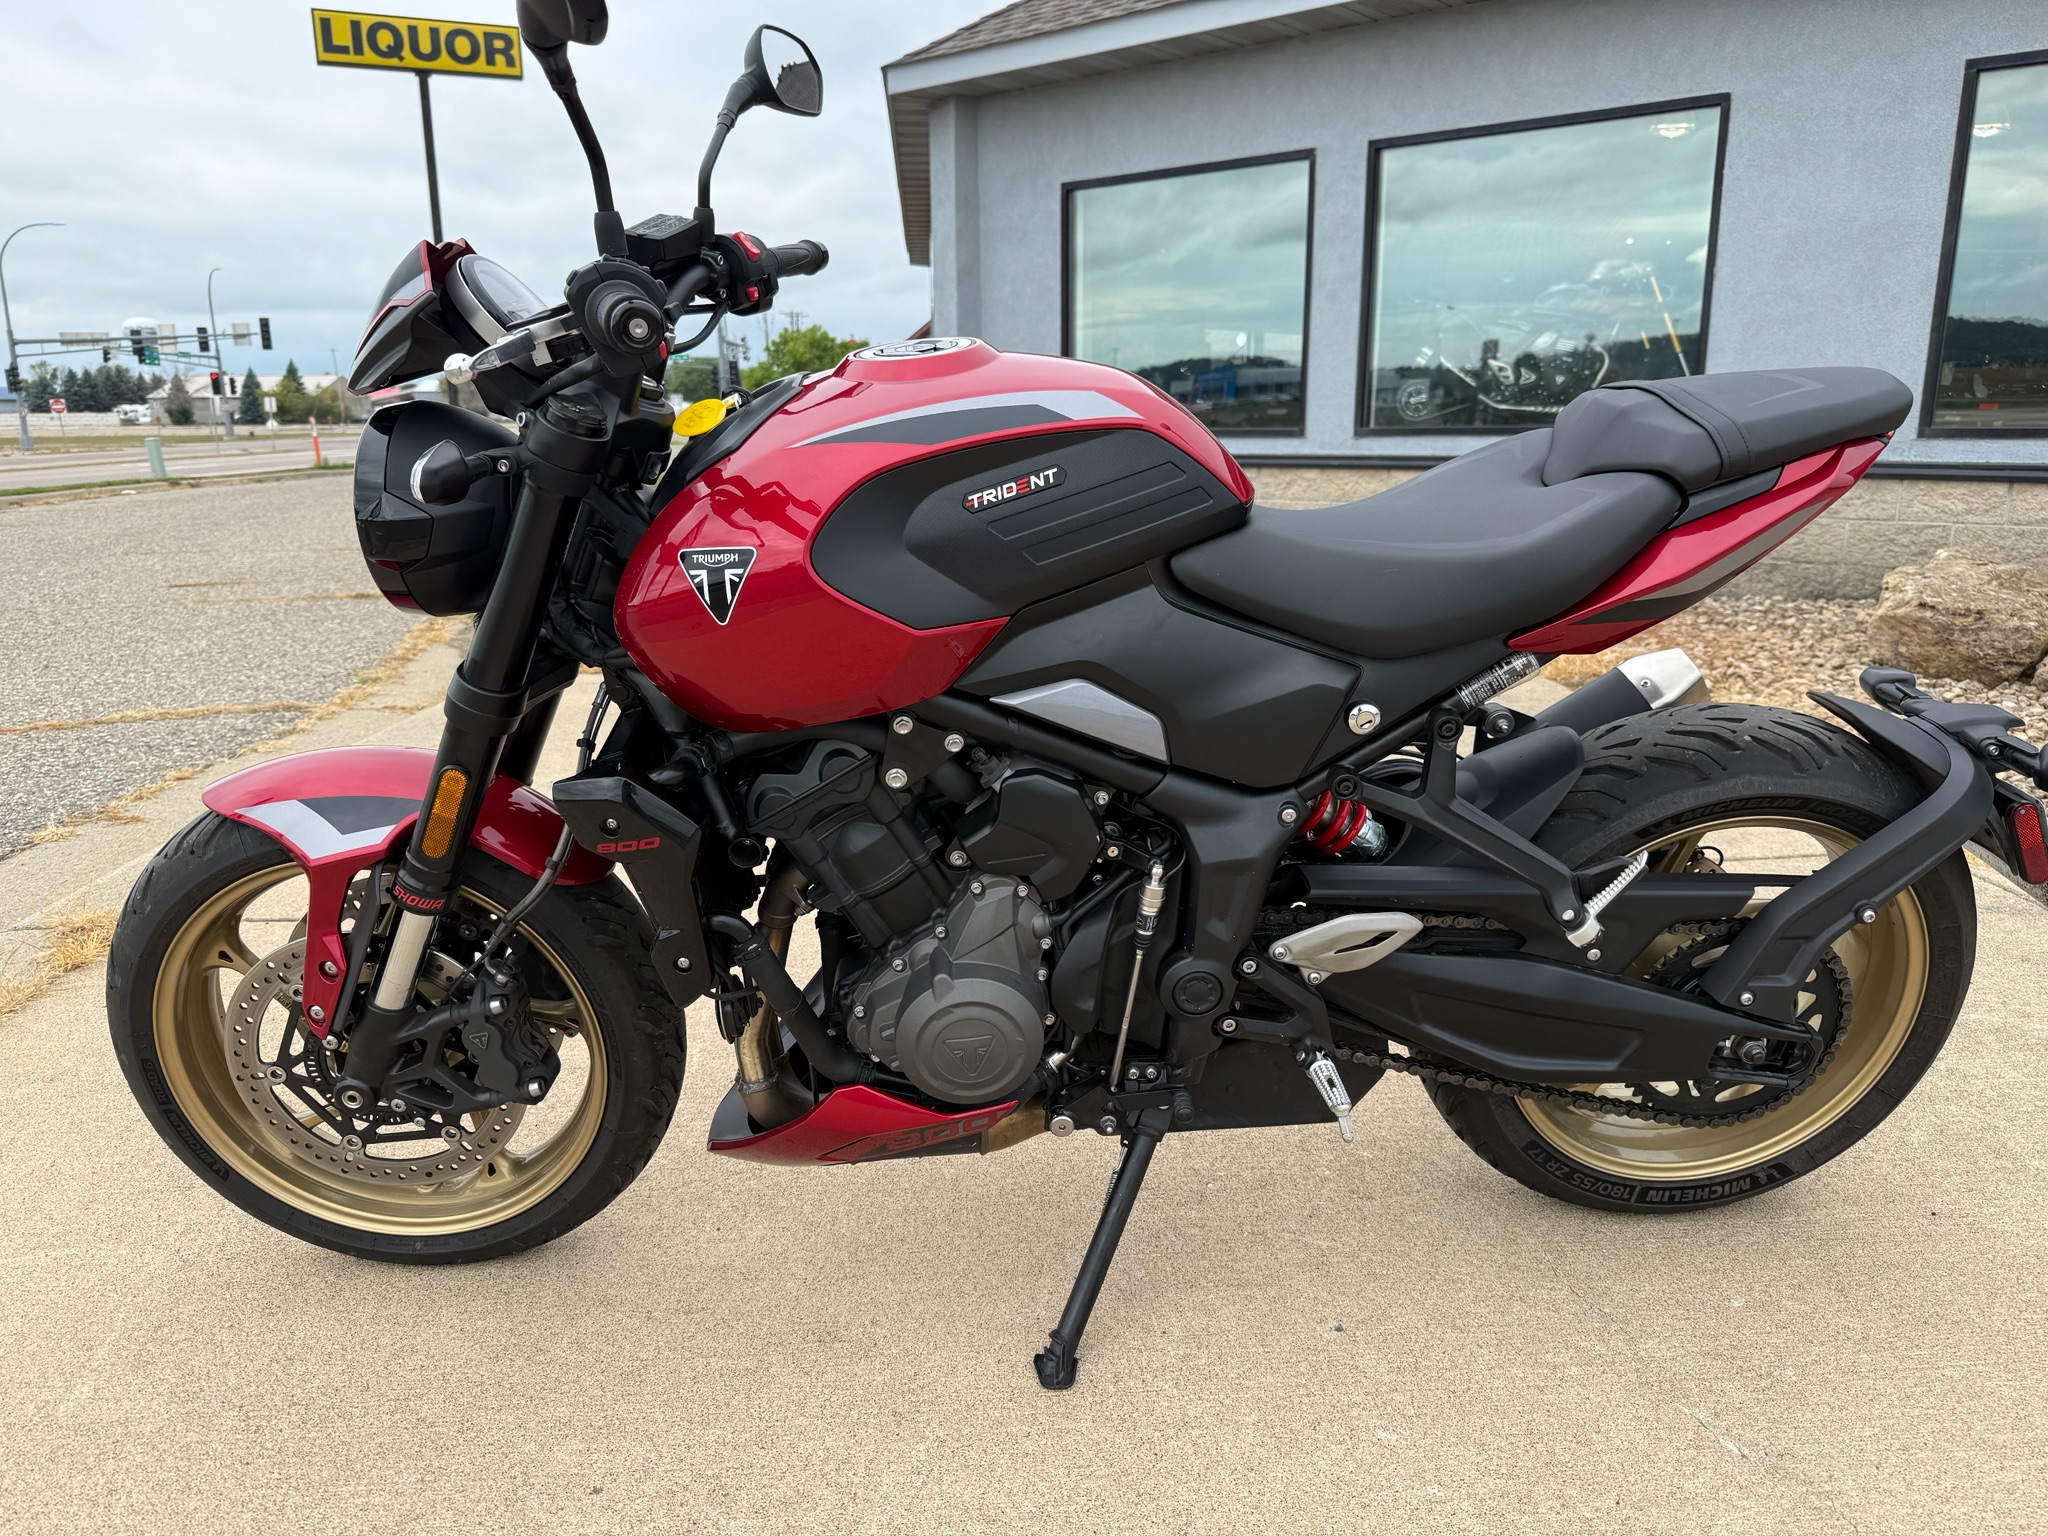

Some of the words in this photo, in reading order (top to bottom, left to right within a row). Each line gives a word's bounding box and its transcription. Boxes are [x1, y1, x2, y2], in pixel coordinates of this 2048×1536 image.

[319, 17, 517, 68] LIQUOR
[966, 467, 1058, 509] TRIDENT
[692, 553, 739, 564] TRIUMPH
[1679, 798, 1801, 824] MICHELIN
[597, 837, 660, 853] 800
[393, 885, 445, 909] SHOWA
[166, 1112, 215, 1166] MICHELIN
[887, 1111, 998, 1149] 800
[1527, 1148, 1545, 1164] 17
[1546, 1159, 1566, 1177] ZR
[1570, 1172, 1632, 1200] 180/55
[1648, 1177, 1750, 1203] MICHELIN
